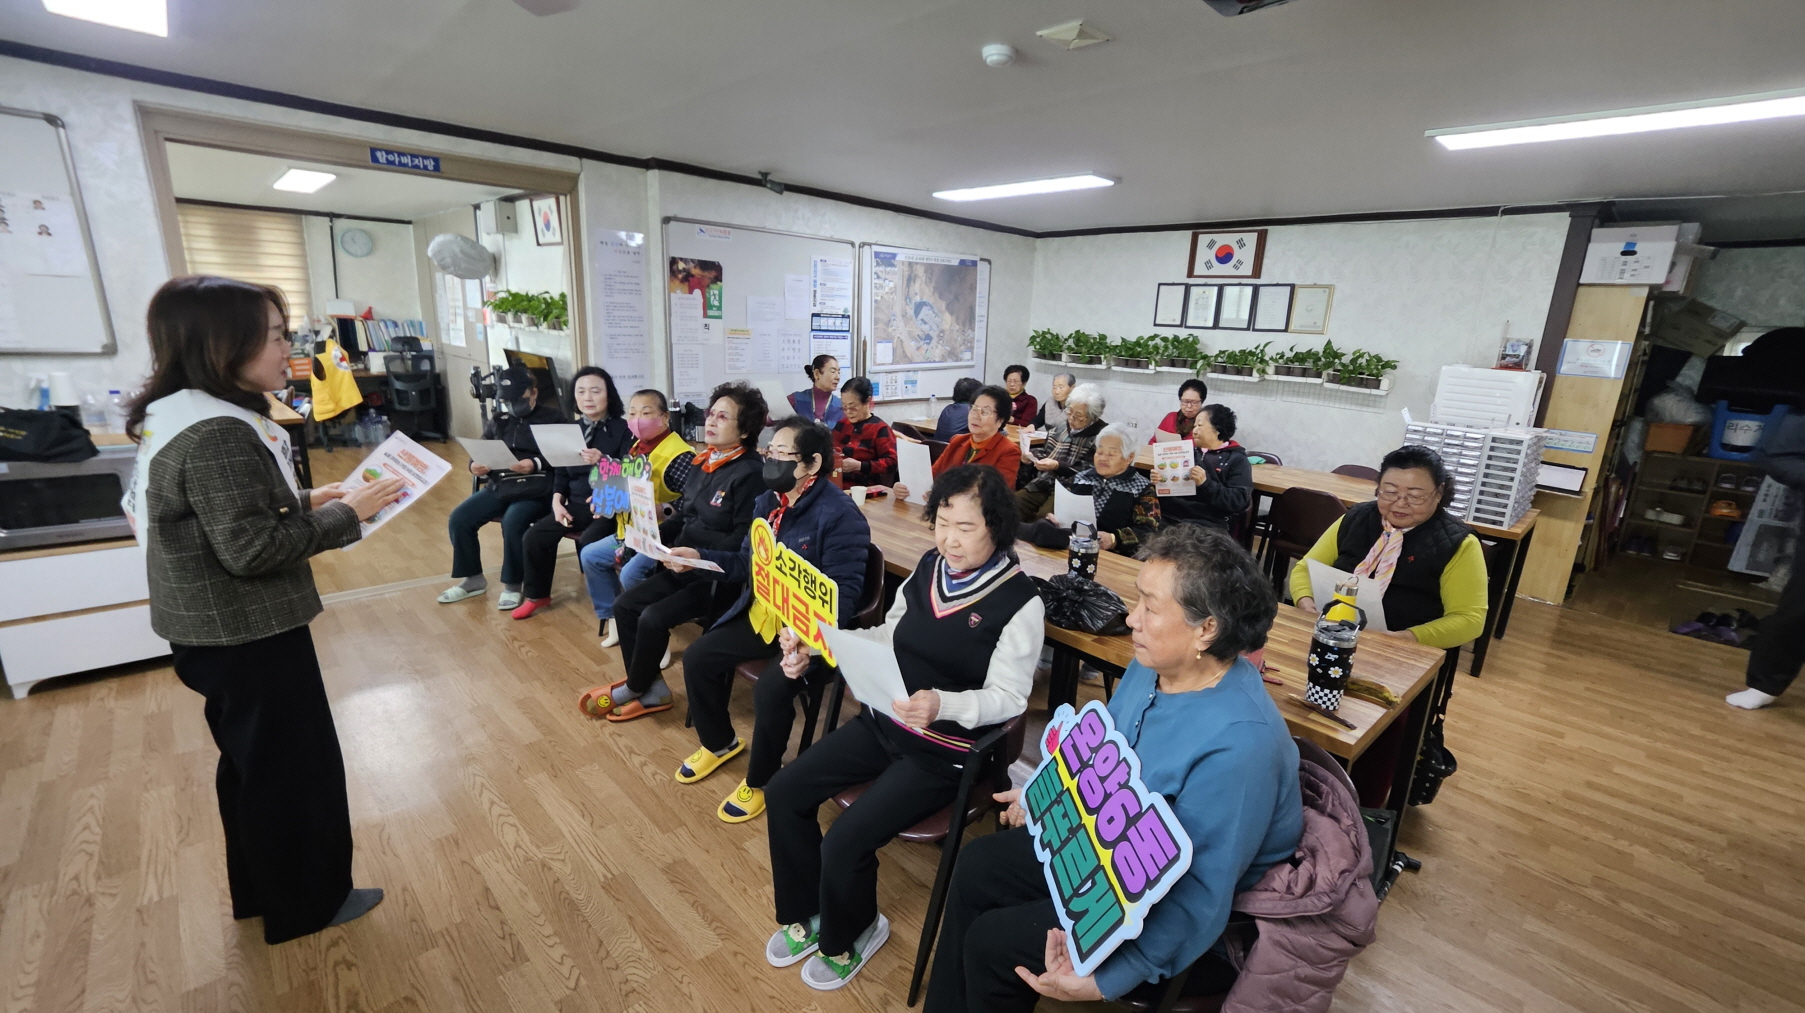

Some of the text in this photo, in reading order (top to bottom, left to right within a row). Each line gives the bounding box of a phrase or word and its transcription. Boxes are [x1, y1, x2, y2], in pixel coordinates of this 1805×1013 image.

[375, 150, 436, 170] 할아버지방
[599, 457, 643, 481] 함께해요
[593, 484, 630, 515] 산불예
[775, 549, 833, 614] 소각행위
[1059, 709, 1180, 896] 온양6동
[1026, 756, 1124, 955] 늘푸르게
